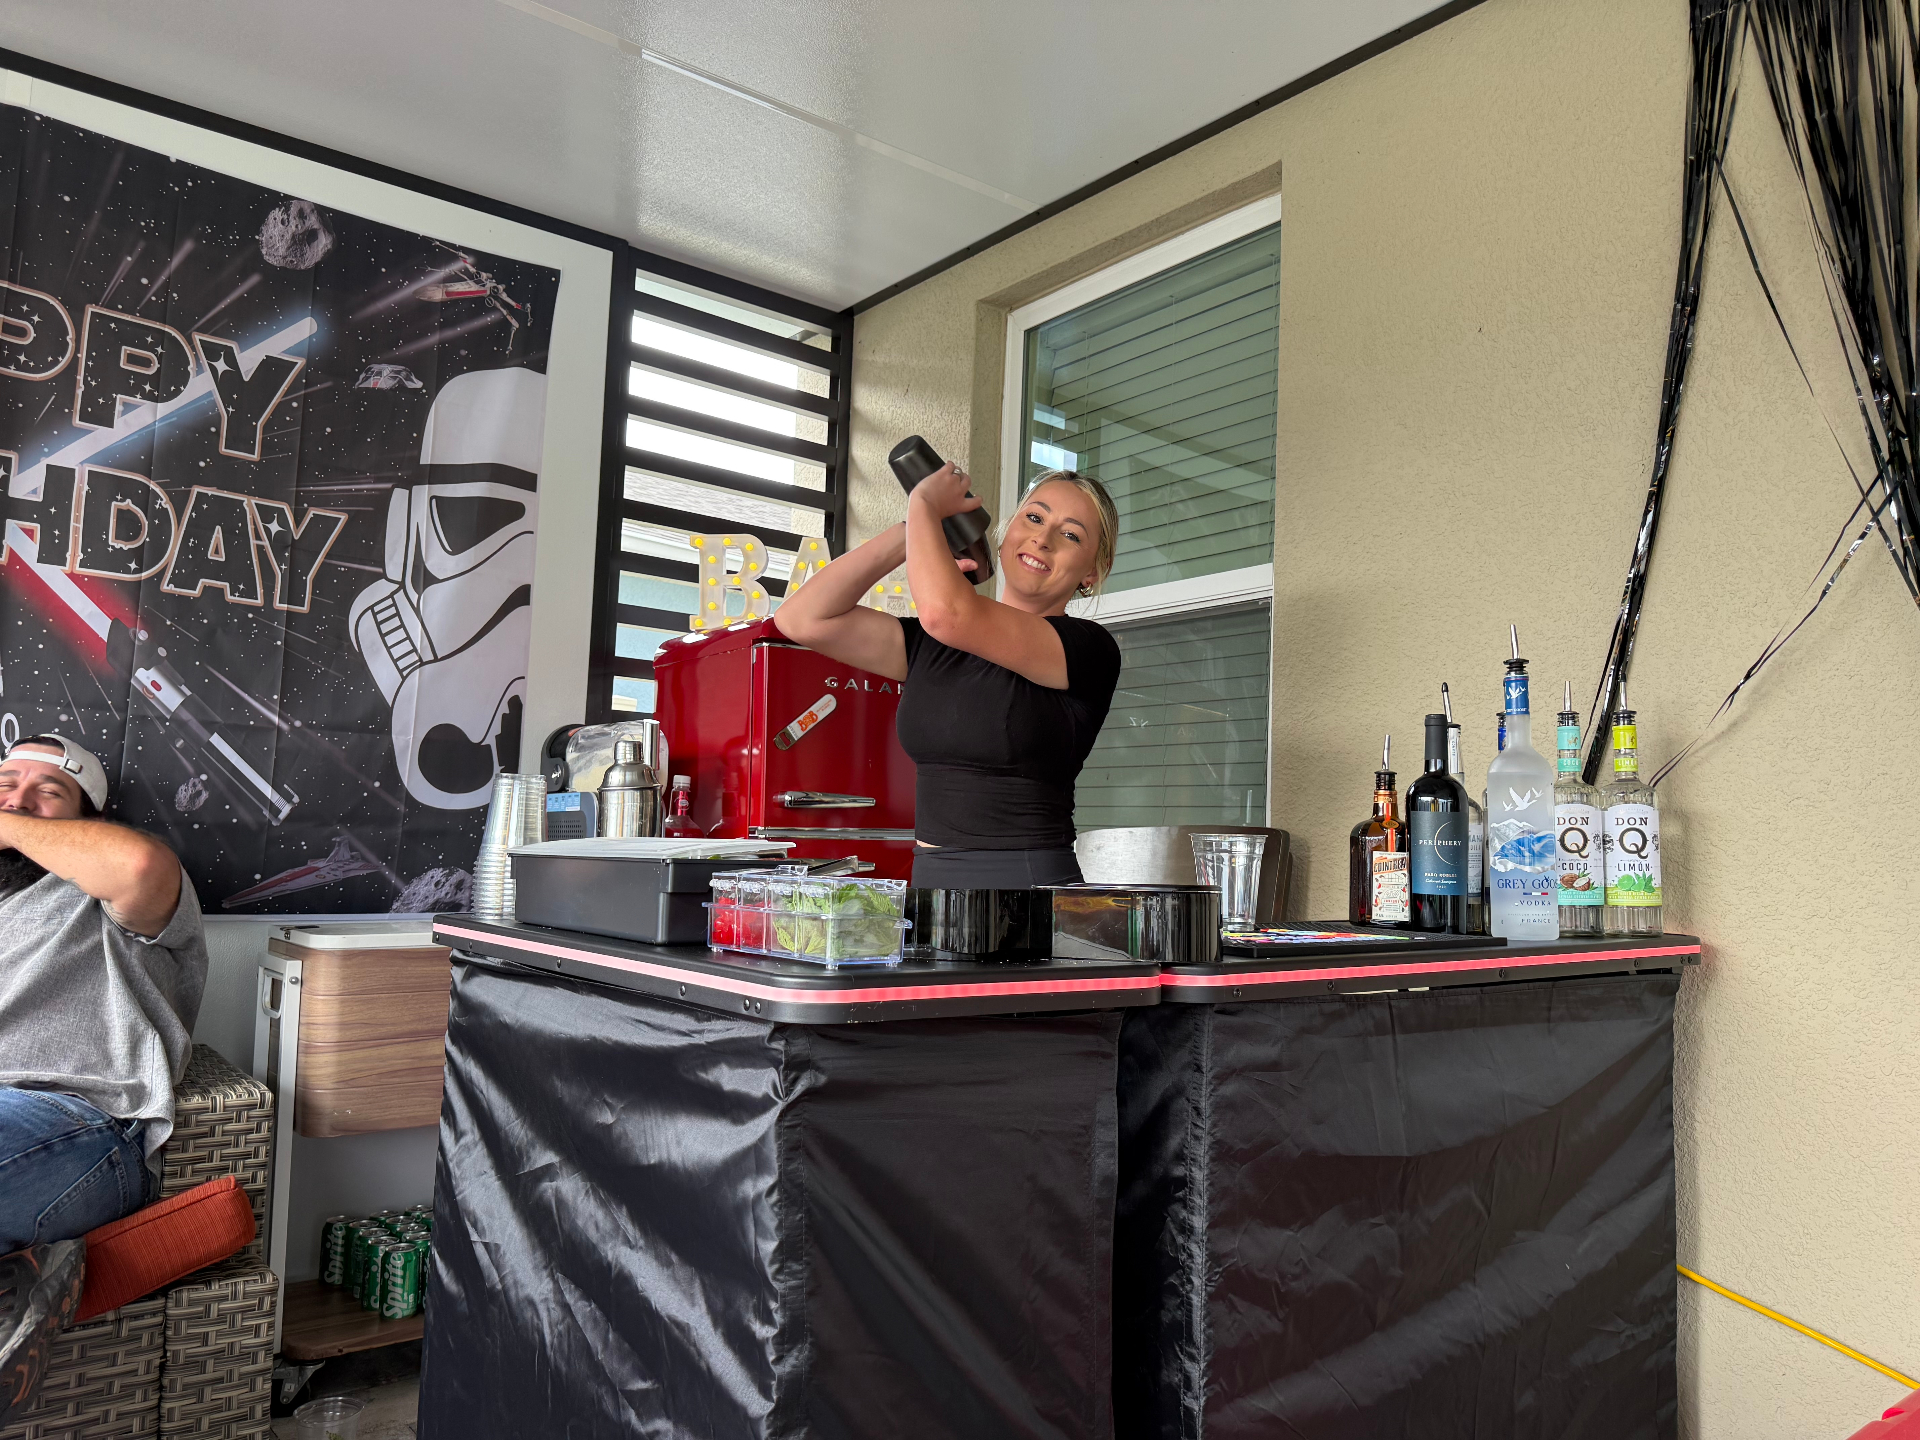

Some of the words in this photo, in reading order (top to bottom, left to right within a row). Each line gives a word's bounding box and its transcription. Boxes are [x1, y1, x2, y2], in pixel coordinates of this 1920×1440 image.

[1557, 817, 1590, 826] DON
[1615, 817, 1649, 826] DON
[1558, 827, 1591, 859] Q
[1617, 827, 1650, 860] Q
[1562, 862, 1588, 871] COCO
[1617, 861, 1650, 872] LIMÓN
[1497, 878, 1527, 890] GREY
[324, 1222, 347, 1285] Sprite
[383, 1252, 408, 1320] Sprite
